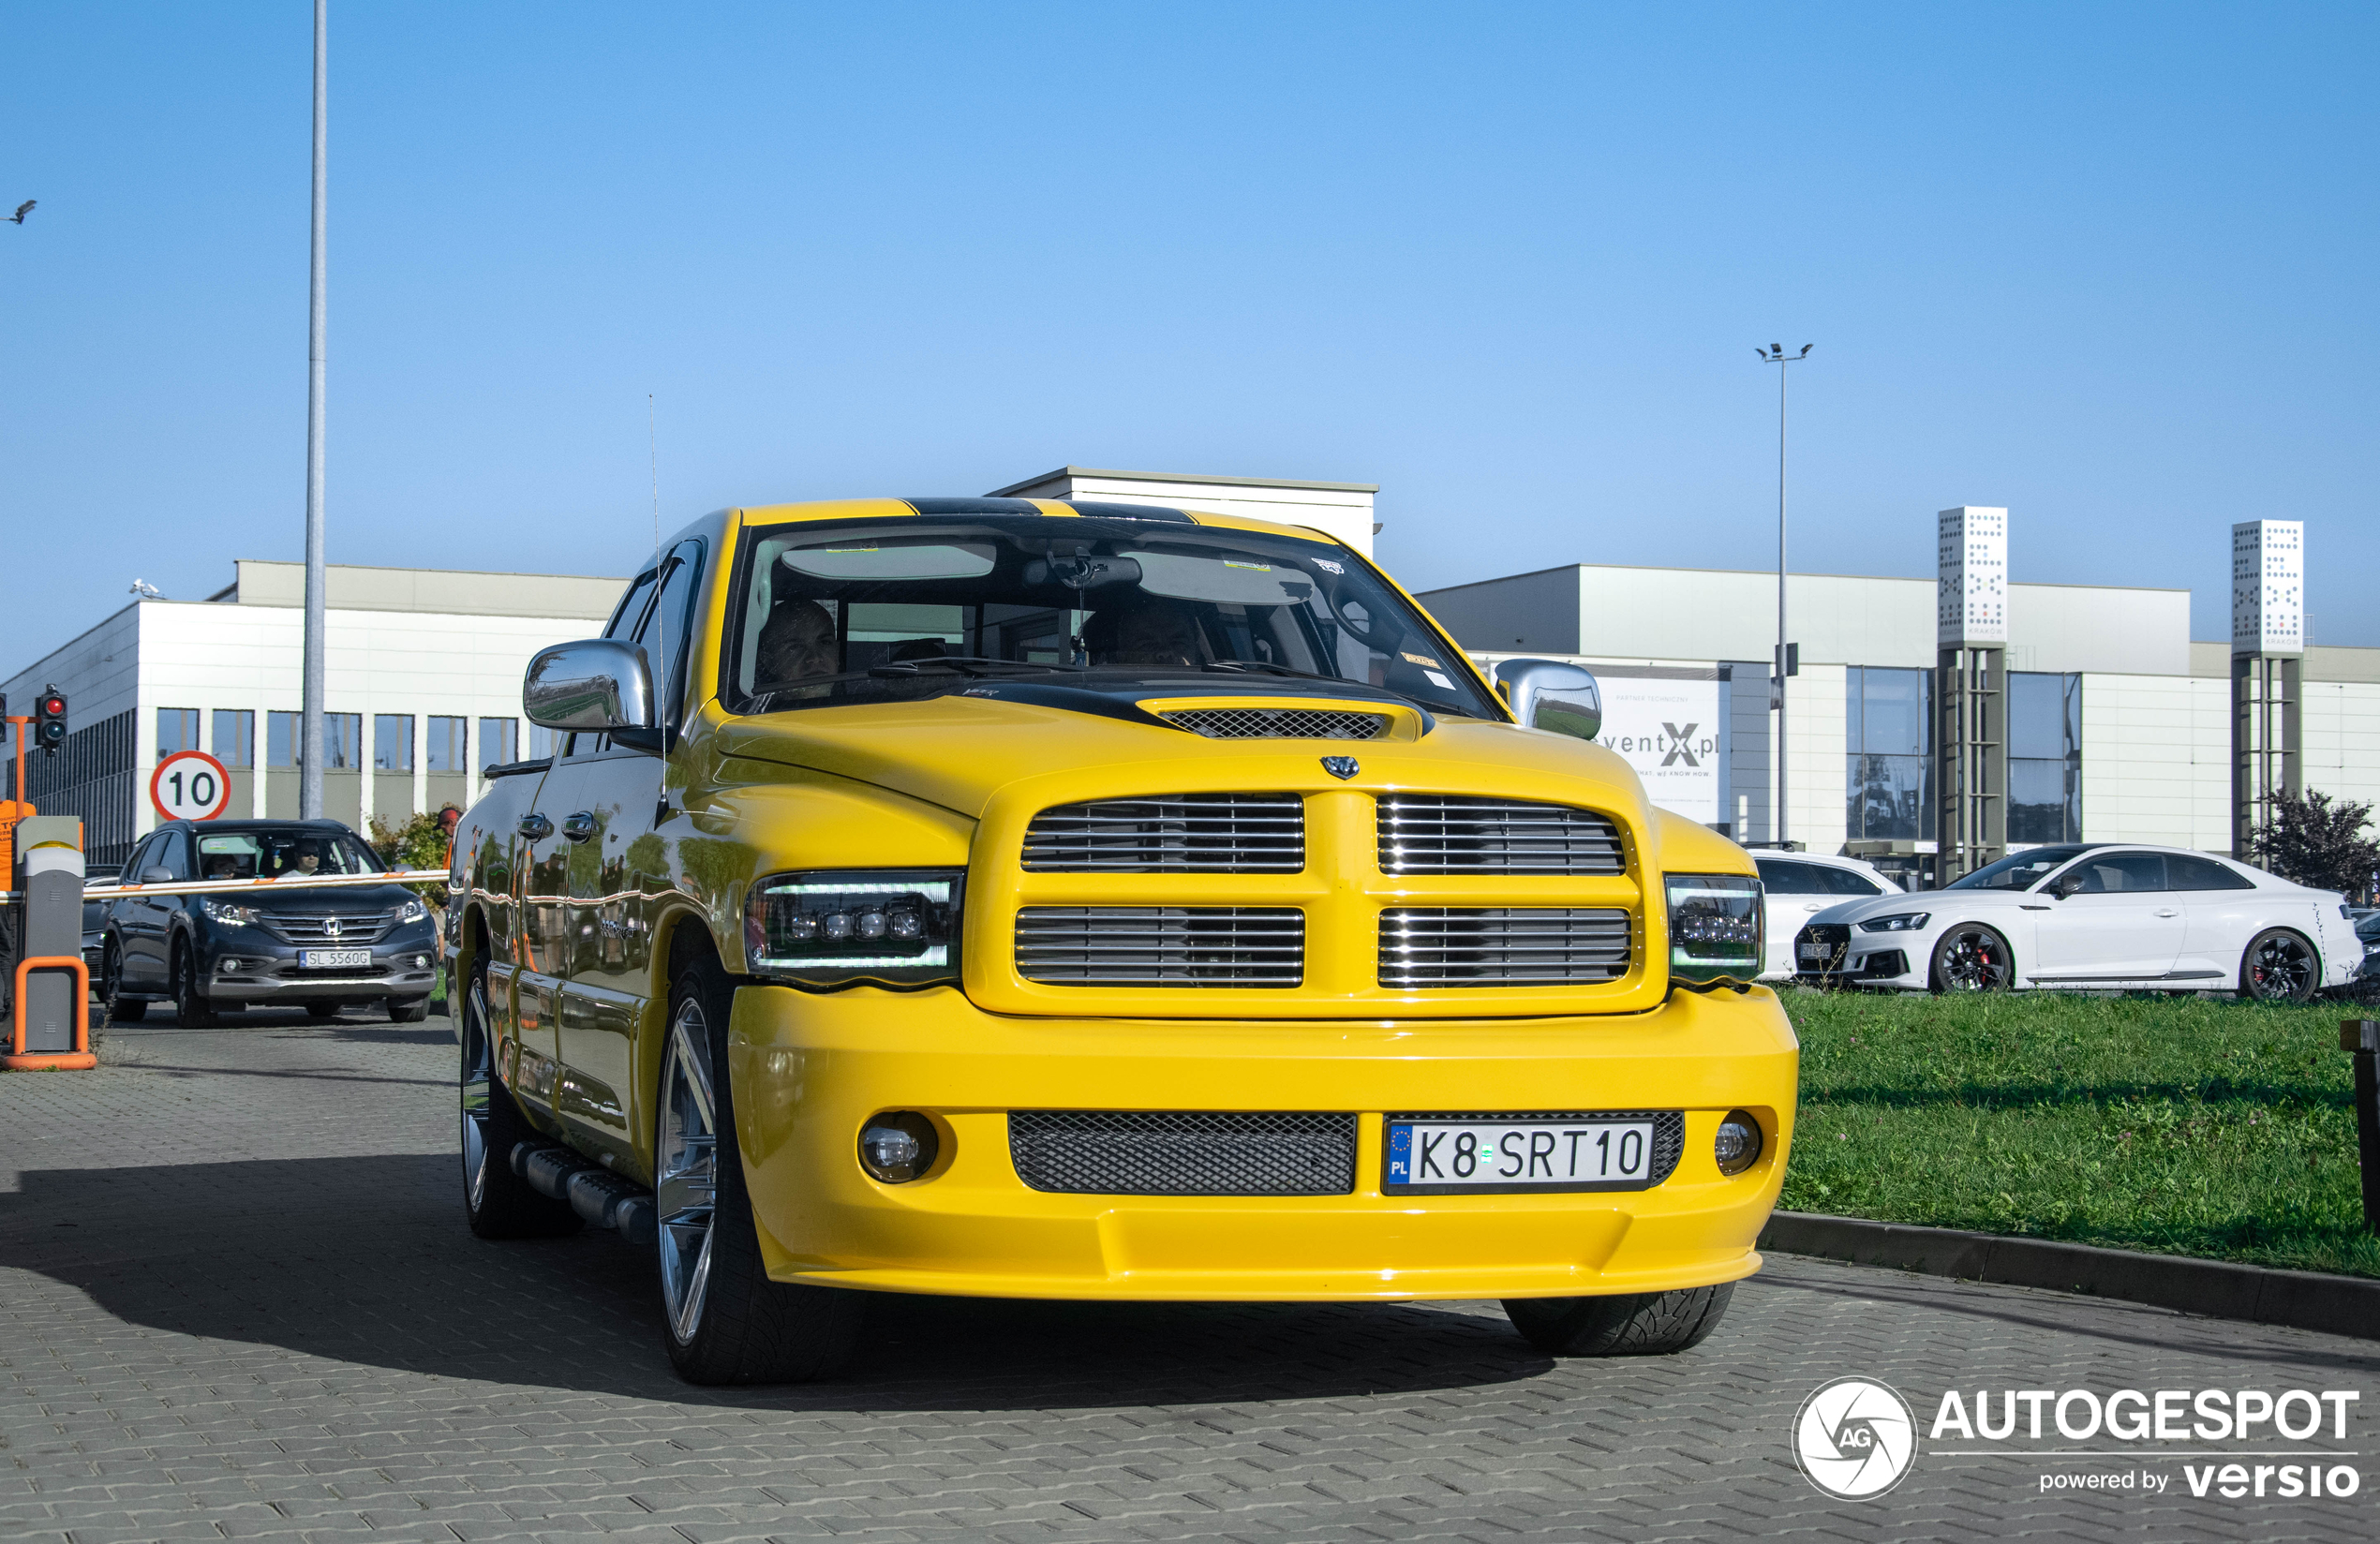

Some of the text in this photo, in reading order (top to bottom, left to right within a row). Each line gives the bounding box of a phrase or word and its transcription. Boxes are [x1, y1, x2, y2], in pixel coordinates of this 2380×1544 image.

[1969, 627, 2002, 635] KRAKÓW
[169, 771, 216, 807] 10
[308, 952, 367, 965] SL 5560G
[1420, 1129, 1644, 1179] K8 SRT10
[1391, 1161, 1407, 1175] PL
